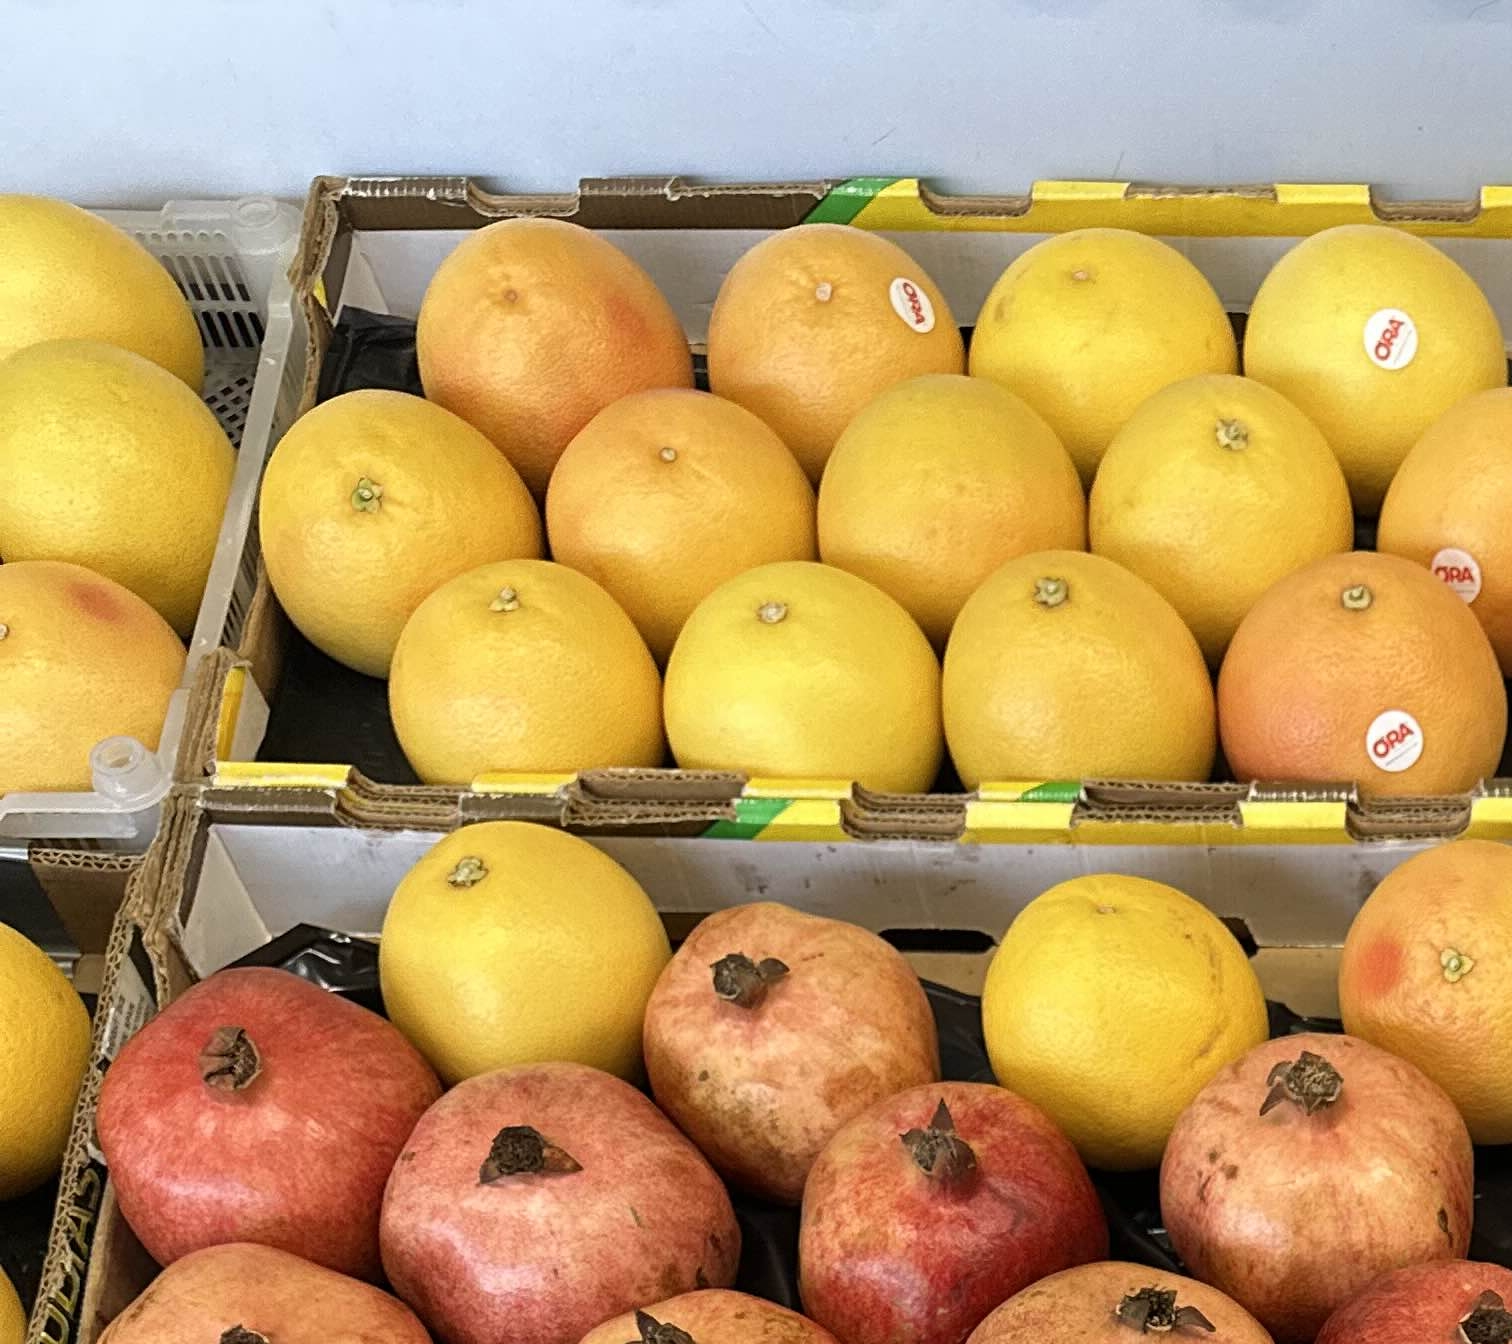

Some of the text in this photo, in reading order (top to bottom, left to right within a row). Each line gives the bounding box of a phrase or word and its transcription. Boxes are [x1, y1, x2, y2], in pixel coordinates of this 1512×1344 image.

[902, 282, 925, 325] ORA
[1374, 319, 1405, 361] ORA
[1373, 723, 1414, 758] ORA
